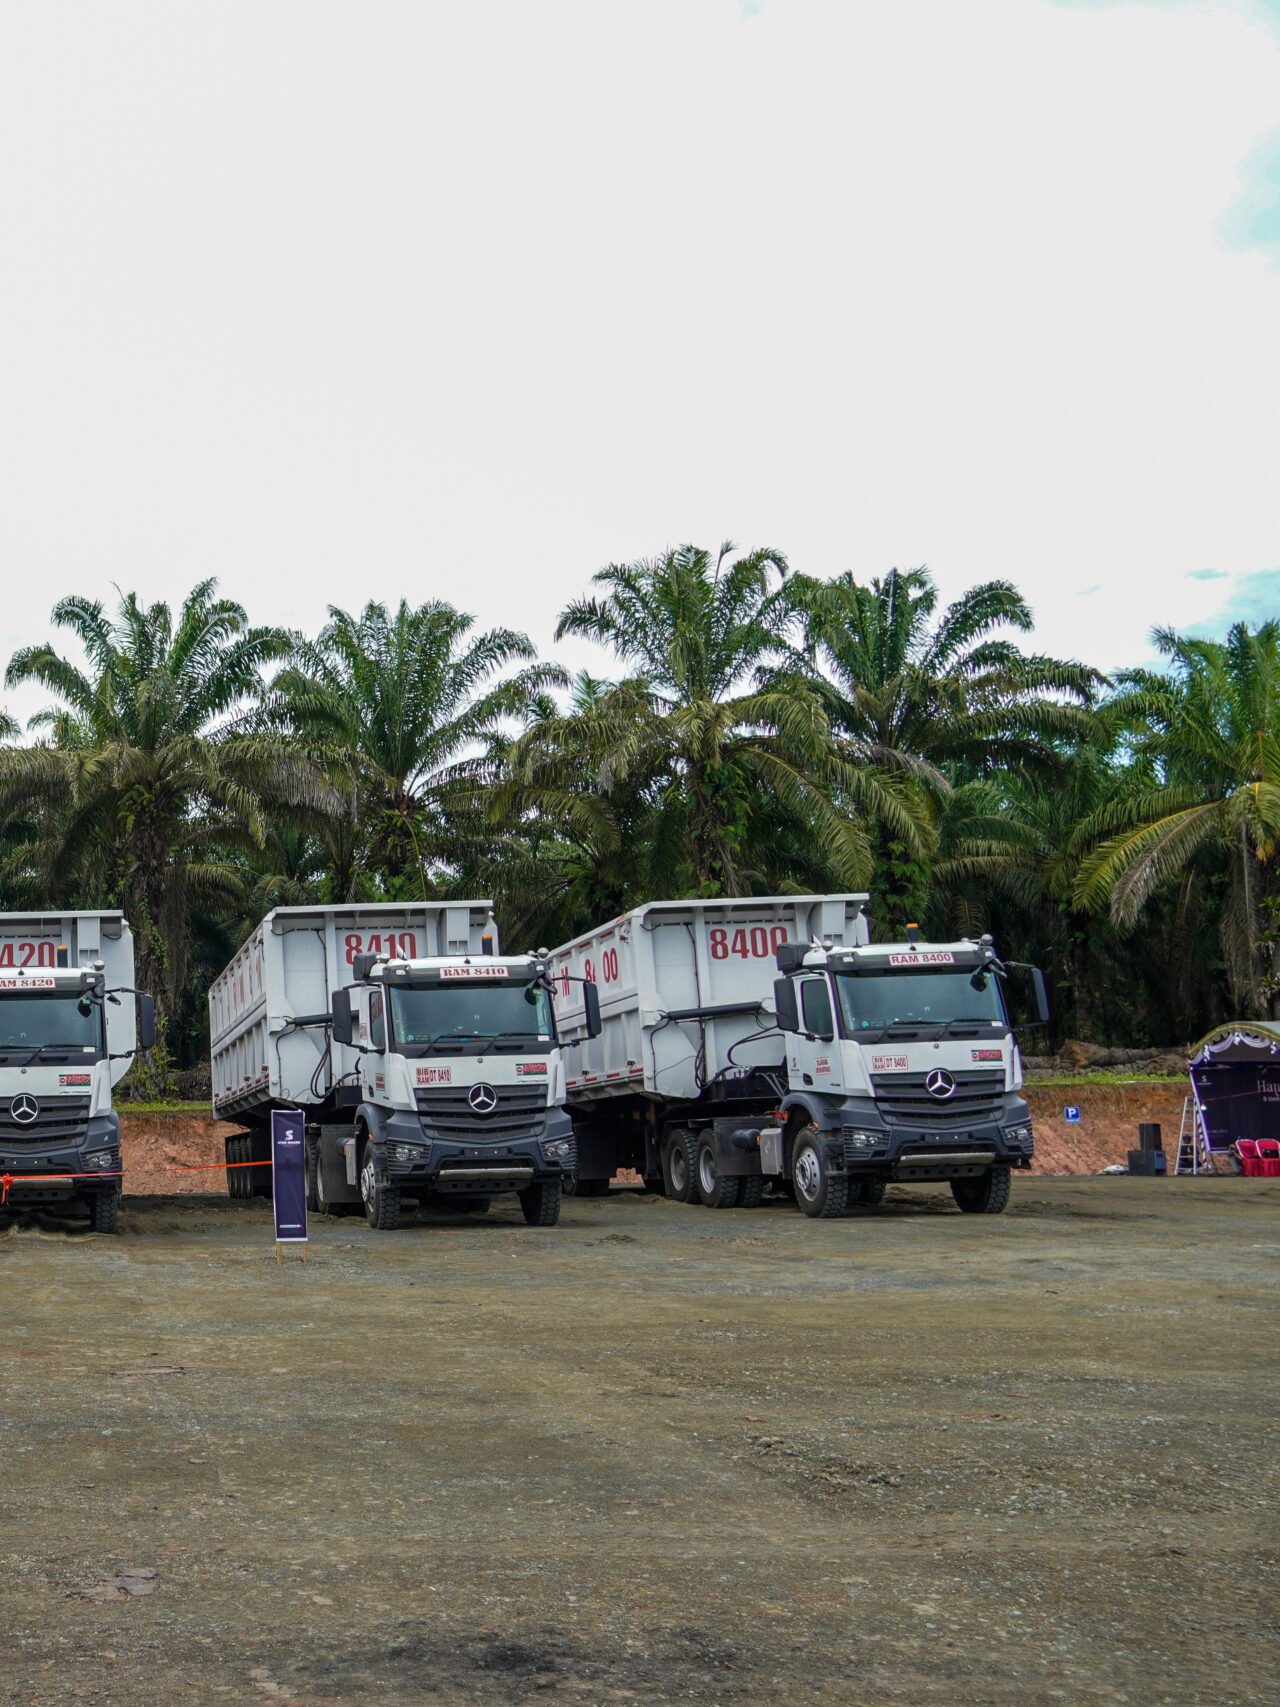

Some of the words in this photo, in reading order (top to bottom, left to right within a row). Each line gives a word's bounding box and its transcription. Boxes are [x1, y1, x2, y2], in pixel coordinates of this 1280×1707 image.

[710, 926, 788, 959] 8400
[891, 955, 919, 964] RAM
[922, 953, 951, 963] 8400
[443, 968, 471, 977] RAM
[474, 967, 505, 976] 8410
[885, 1058, 893, 1068] DT
[429, 1070, 437, 1082] DT
[1068, 1108, 1076, 1118] P
